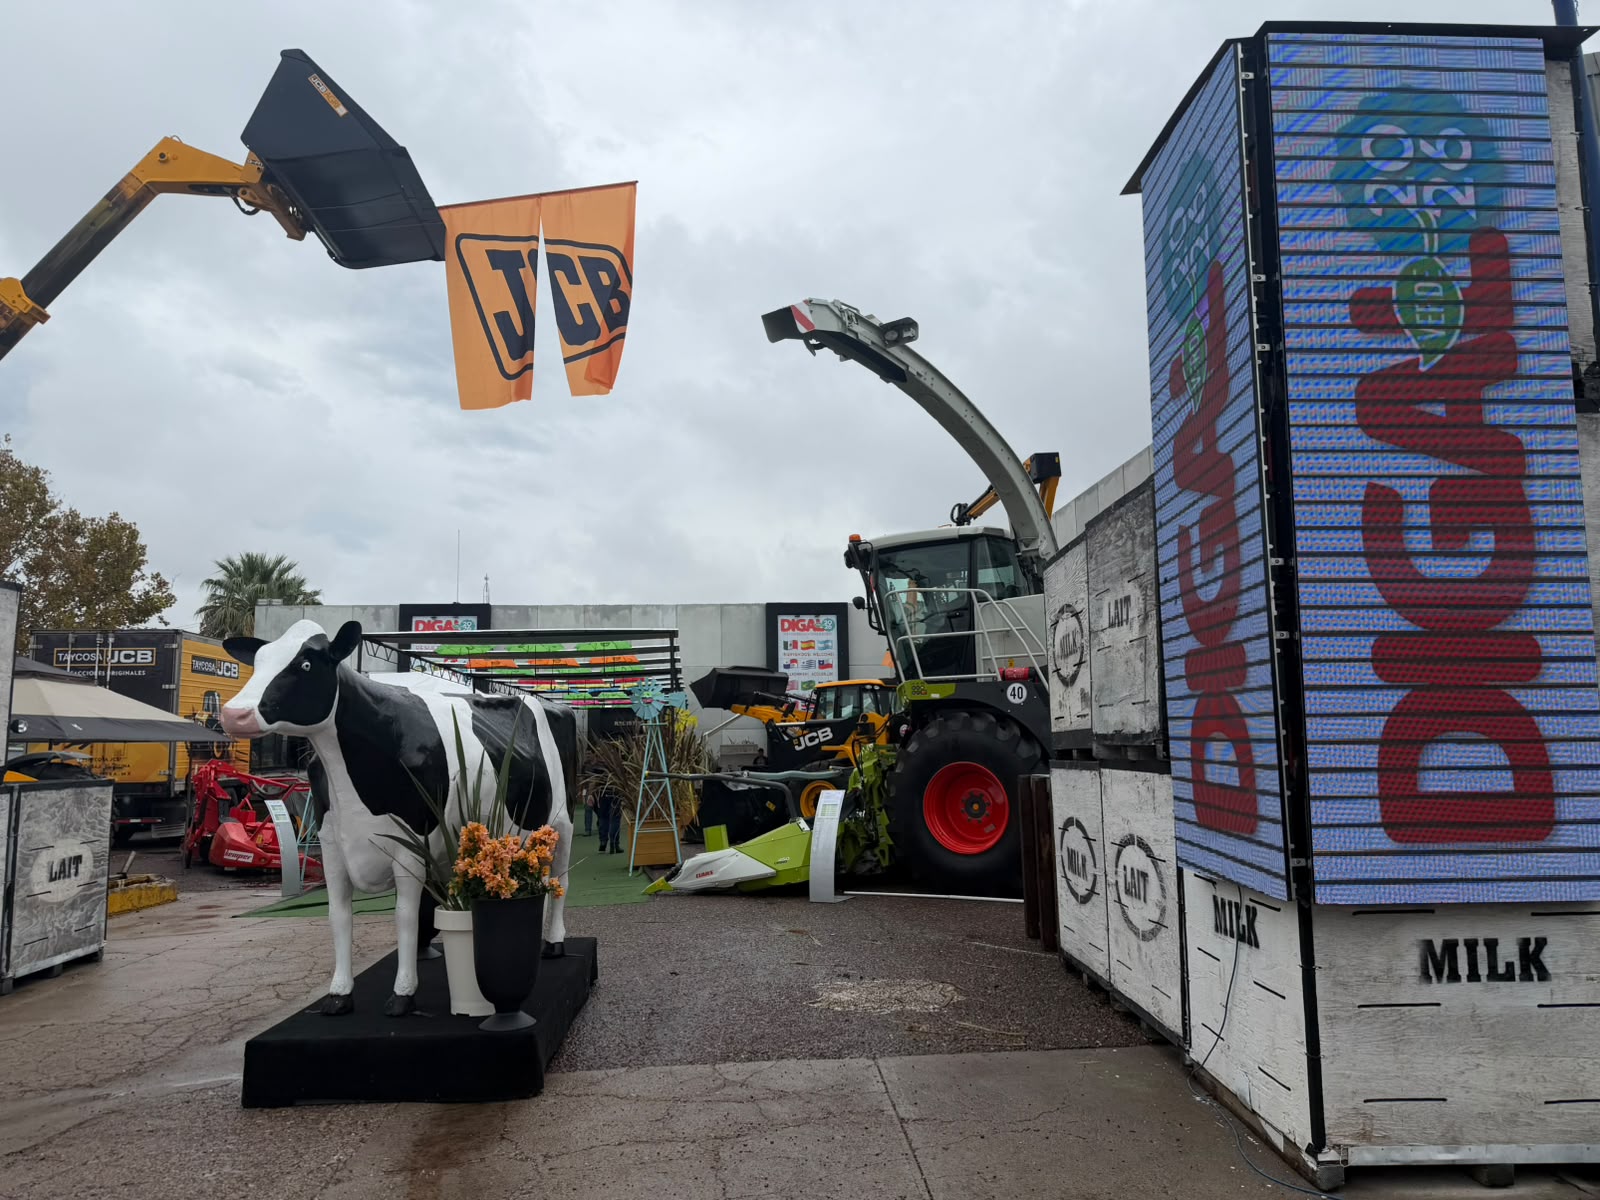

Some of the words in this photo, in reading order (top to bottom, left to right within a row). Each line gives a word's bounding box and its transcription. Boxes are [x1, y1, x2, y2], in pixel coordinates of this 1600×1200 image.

[310, 76, 327, 93] JCB
[323, 92, 341, 109] AGRI
[1361, 124, 1420, 217] 20
[1421, 128, 1477, 219] 26
[485, 247, 631, 361] JCB
[1108, 595, 1131, 628] LAIT
[58, 653, 103, 661] TAYCOSA
[107, 650, 152, 663] JCB
[192, 659, 216, 672] TAYCOSA
[217, 661, 239, 678] JCB
[1010, 687, 1023, 700] 40
[794, 727, 833, 751] JCB
[48, 855, 83, 883] LAIT
[1067, 846, 1088, 881] MILK
[1123, 864, 1149, 904] LAIT
[1212, 895, 1260, 949] MILK
[1418, 937, 1551, 985] MILK
